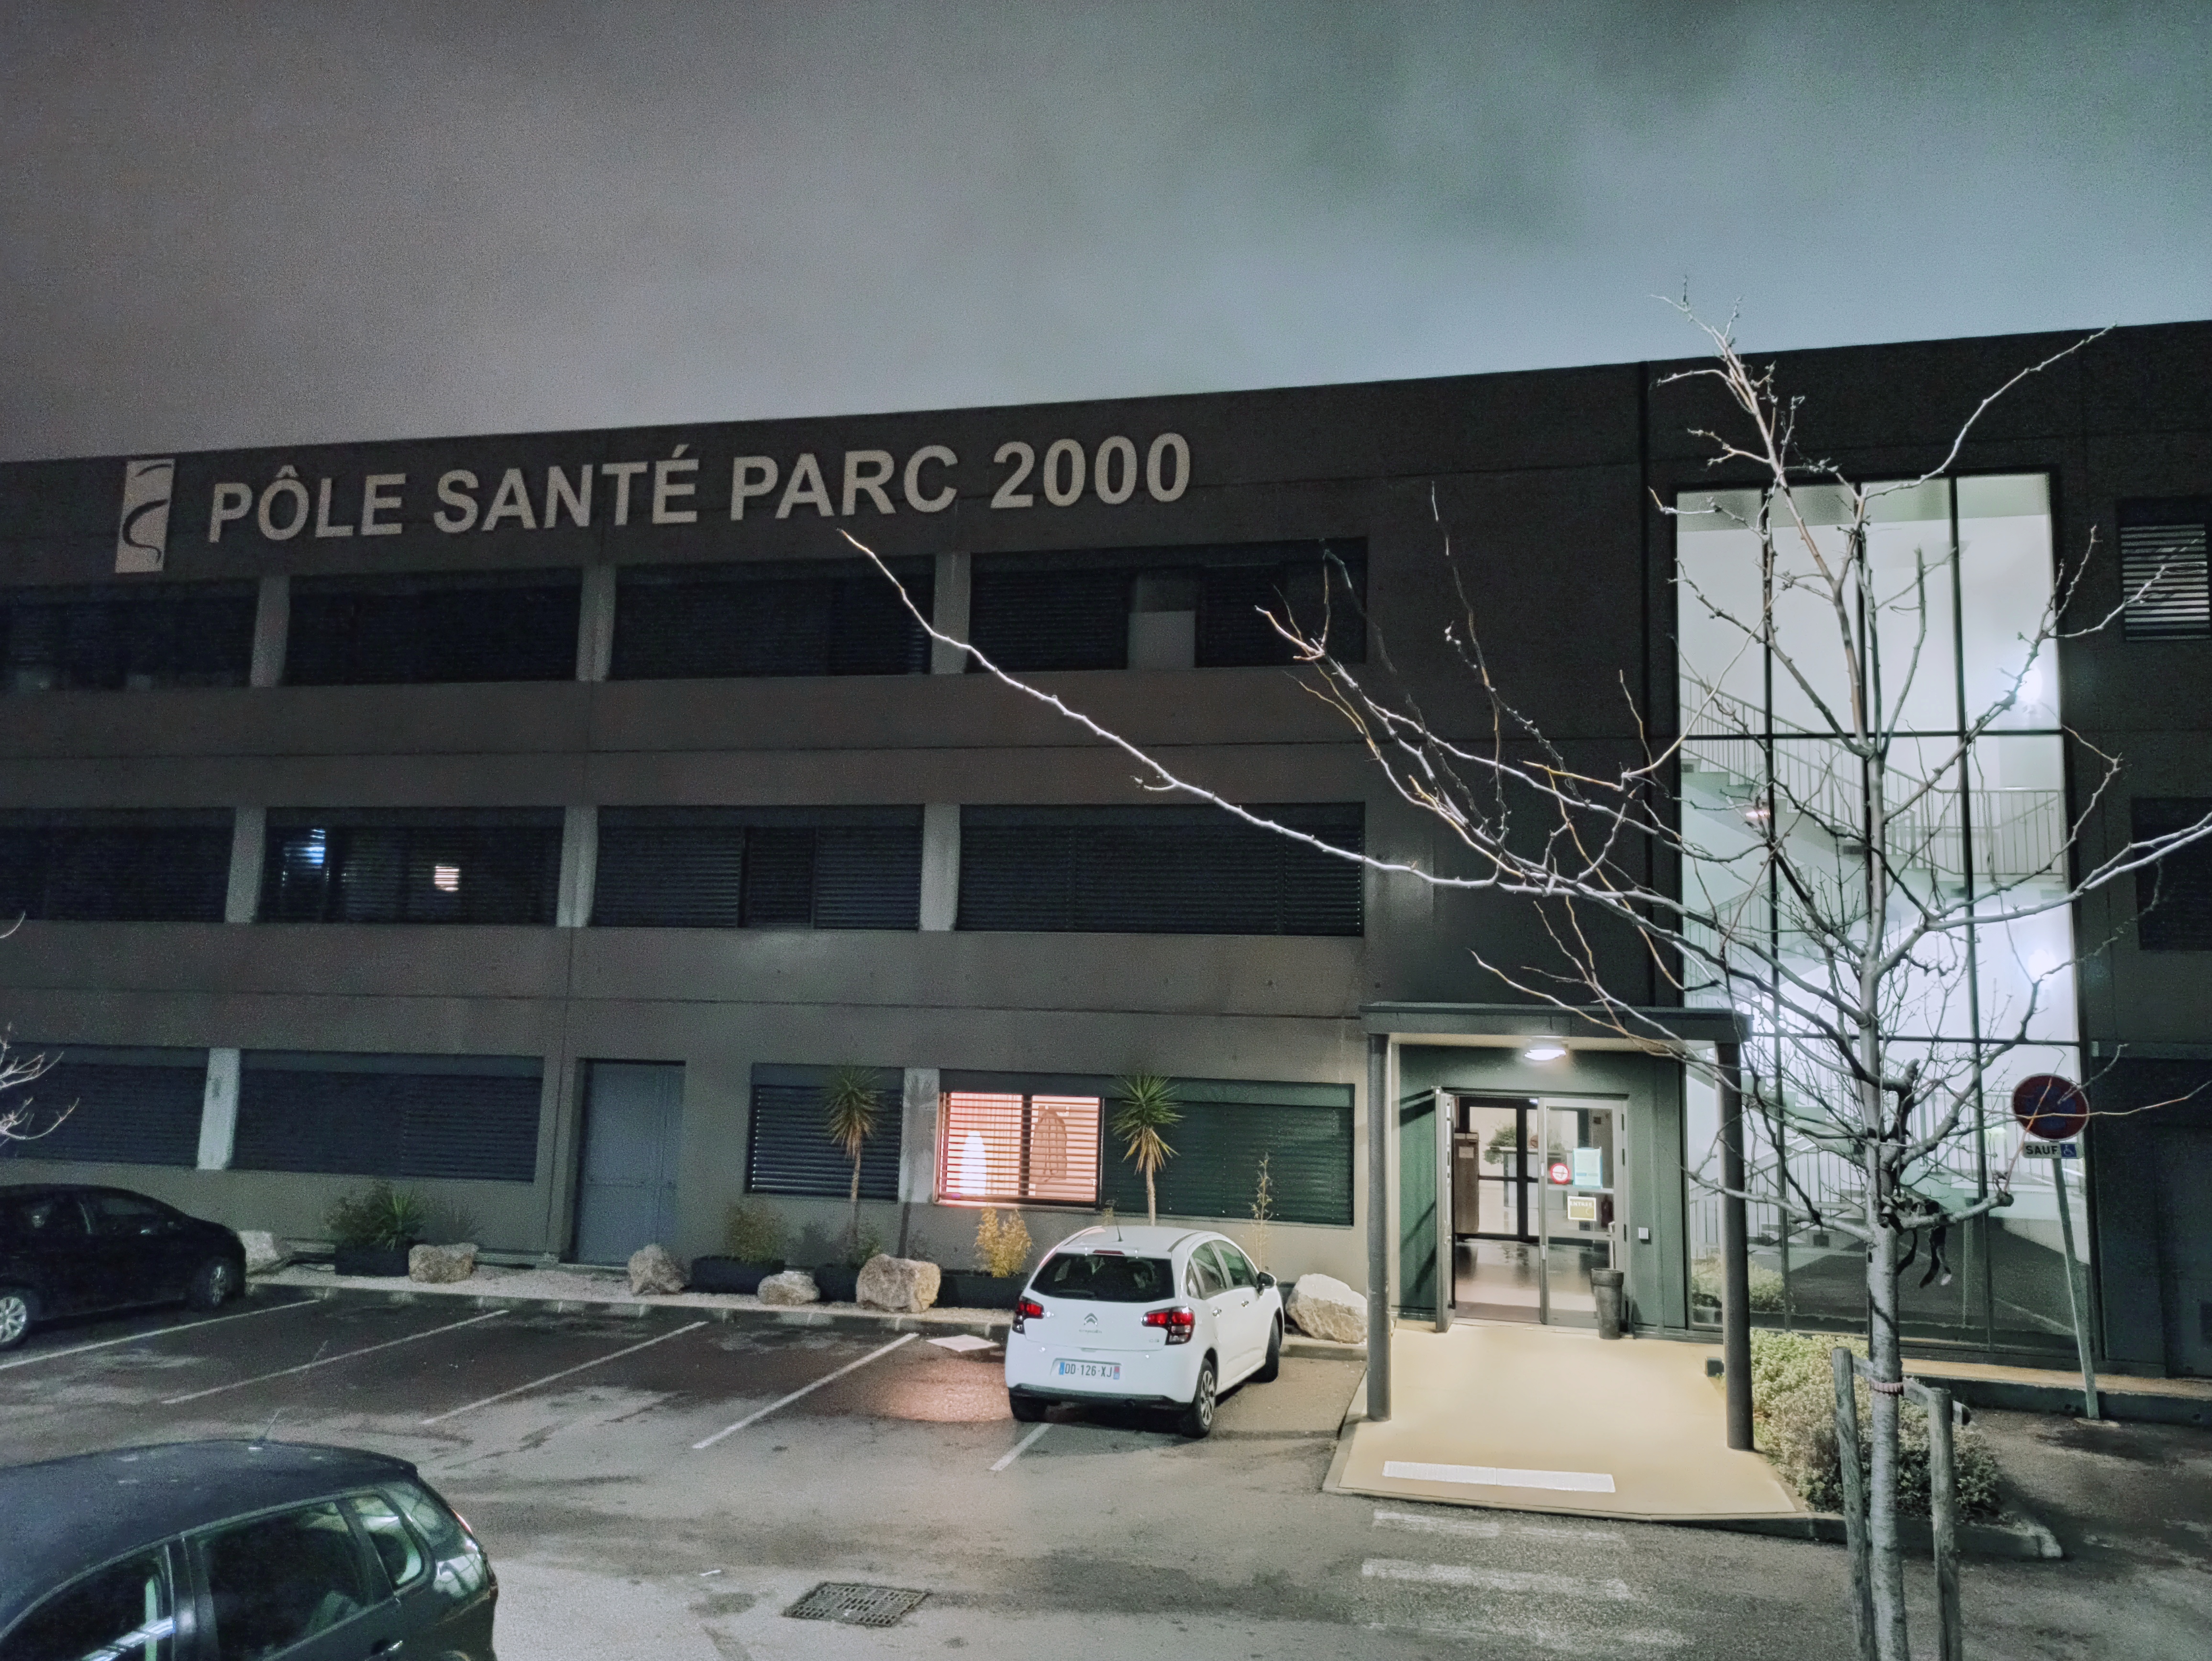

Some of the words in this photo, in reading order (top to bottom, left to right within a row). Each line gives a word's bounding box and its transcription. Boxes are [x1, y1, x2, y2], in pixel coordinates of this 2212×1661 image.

[208, 465, 406, 543] PÔLE
[433, 444, 699, 533] SANTÉ
[730, 445, 958, 521] PARC
[990, 432, 1191, 509] 2000
[2025, 1145, 2058, 1155] SAUF
